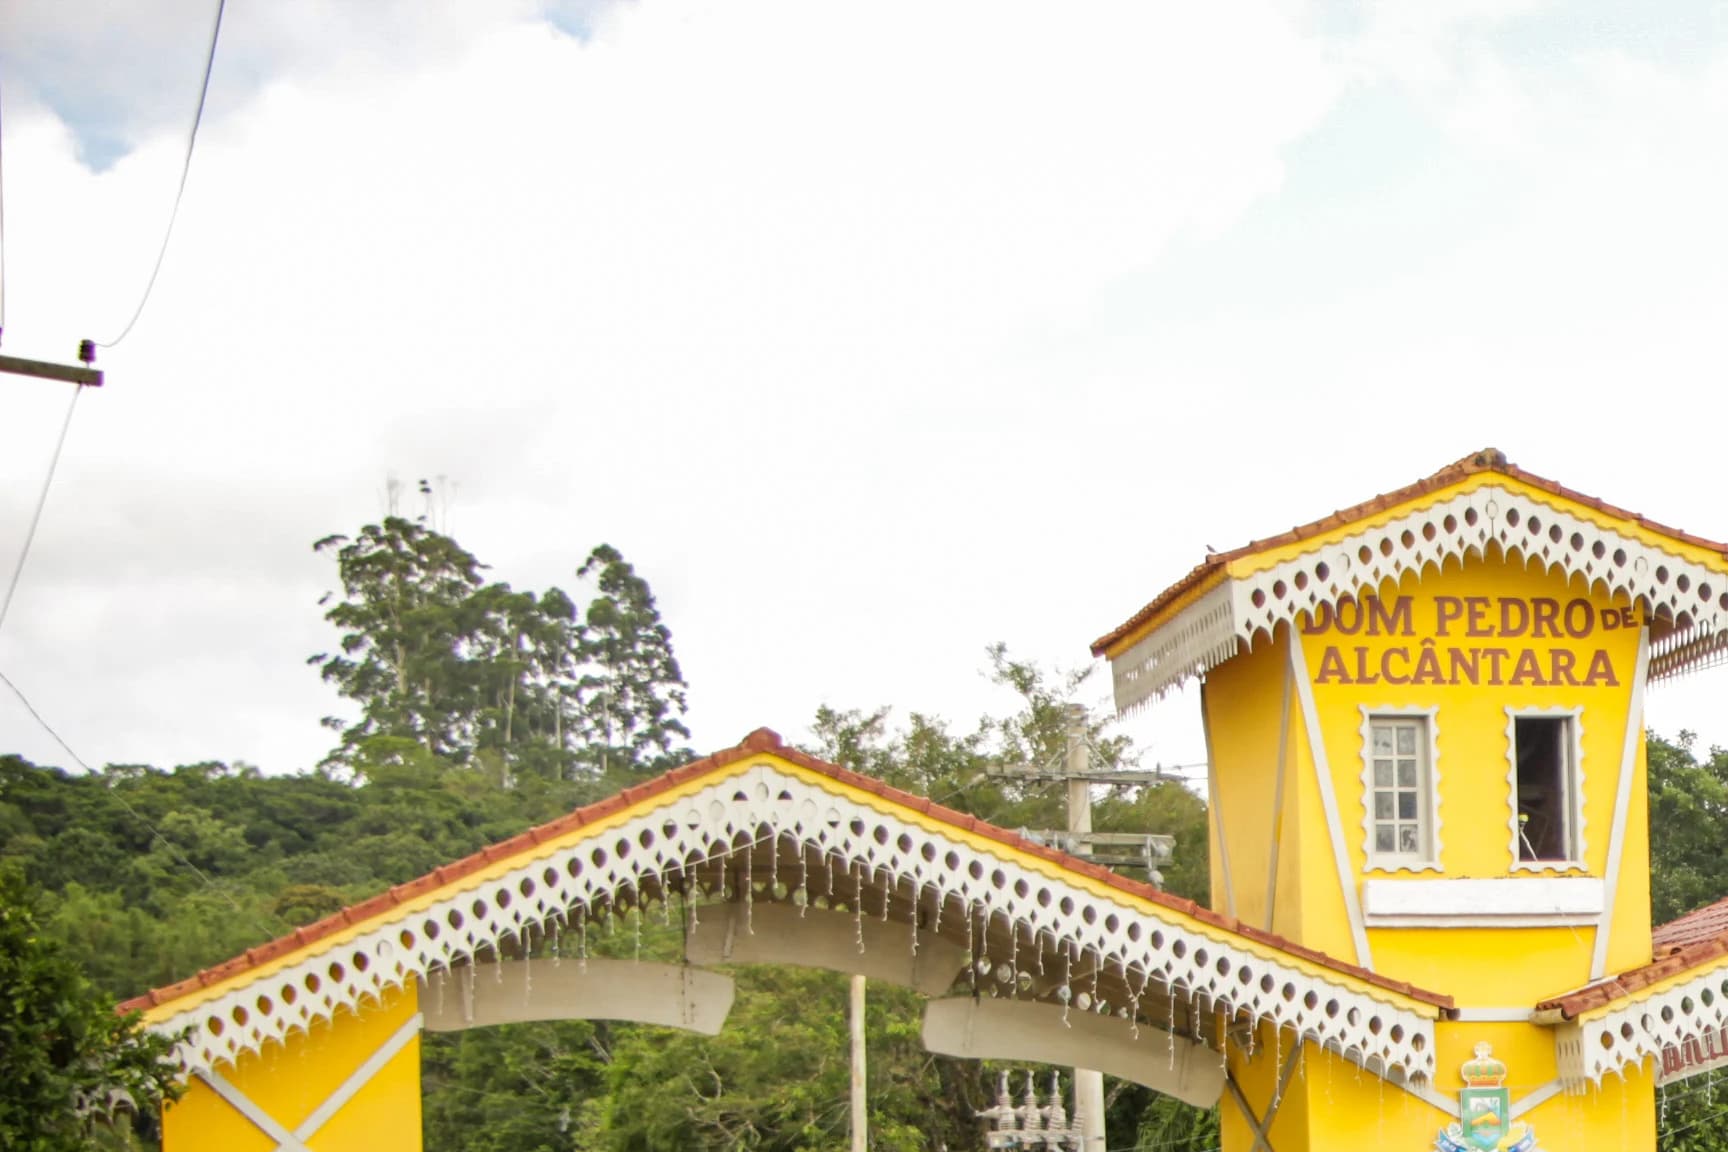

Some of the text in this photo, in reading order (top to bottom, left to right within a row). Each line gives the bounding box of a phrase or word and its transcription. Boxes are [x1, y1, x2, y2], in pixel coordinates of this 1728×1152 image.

[1302, 594, 1639, 639] DOM PEDRO DE
[1314, 637, 1620, 687] ALCÂNTARA
